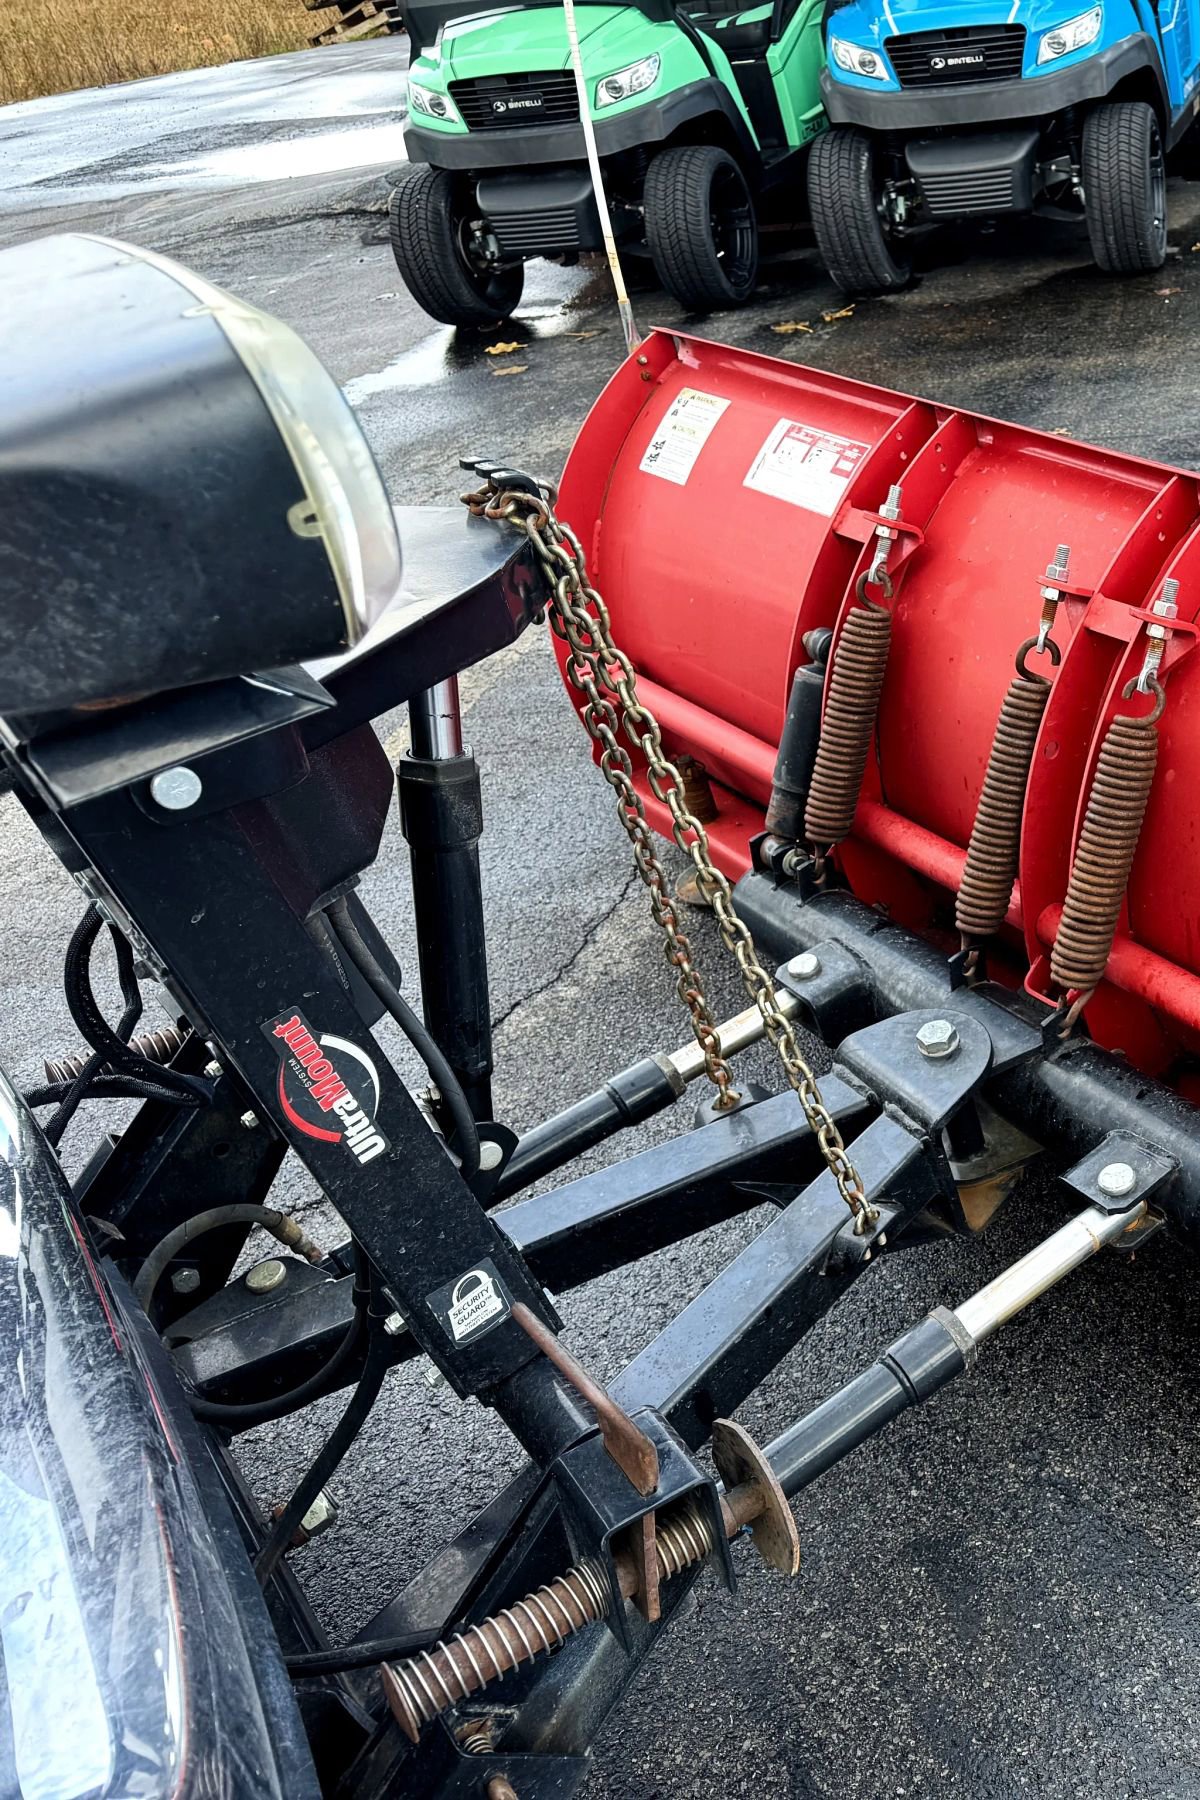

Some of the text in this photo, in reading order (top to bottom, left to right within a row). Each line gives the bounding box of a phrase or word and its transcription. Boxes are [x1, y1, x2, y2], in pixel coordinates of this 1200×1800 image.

[288, 1057, 312, 1088] SYSTEM
[272, 1014, 386, 1165] UltraMount
[452, 1286, 490, 1319] SECURITY
